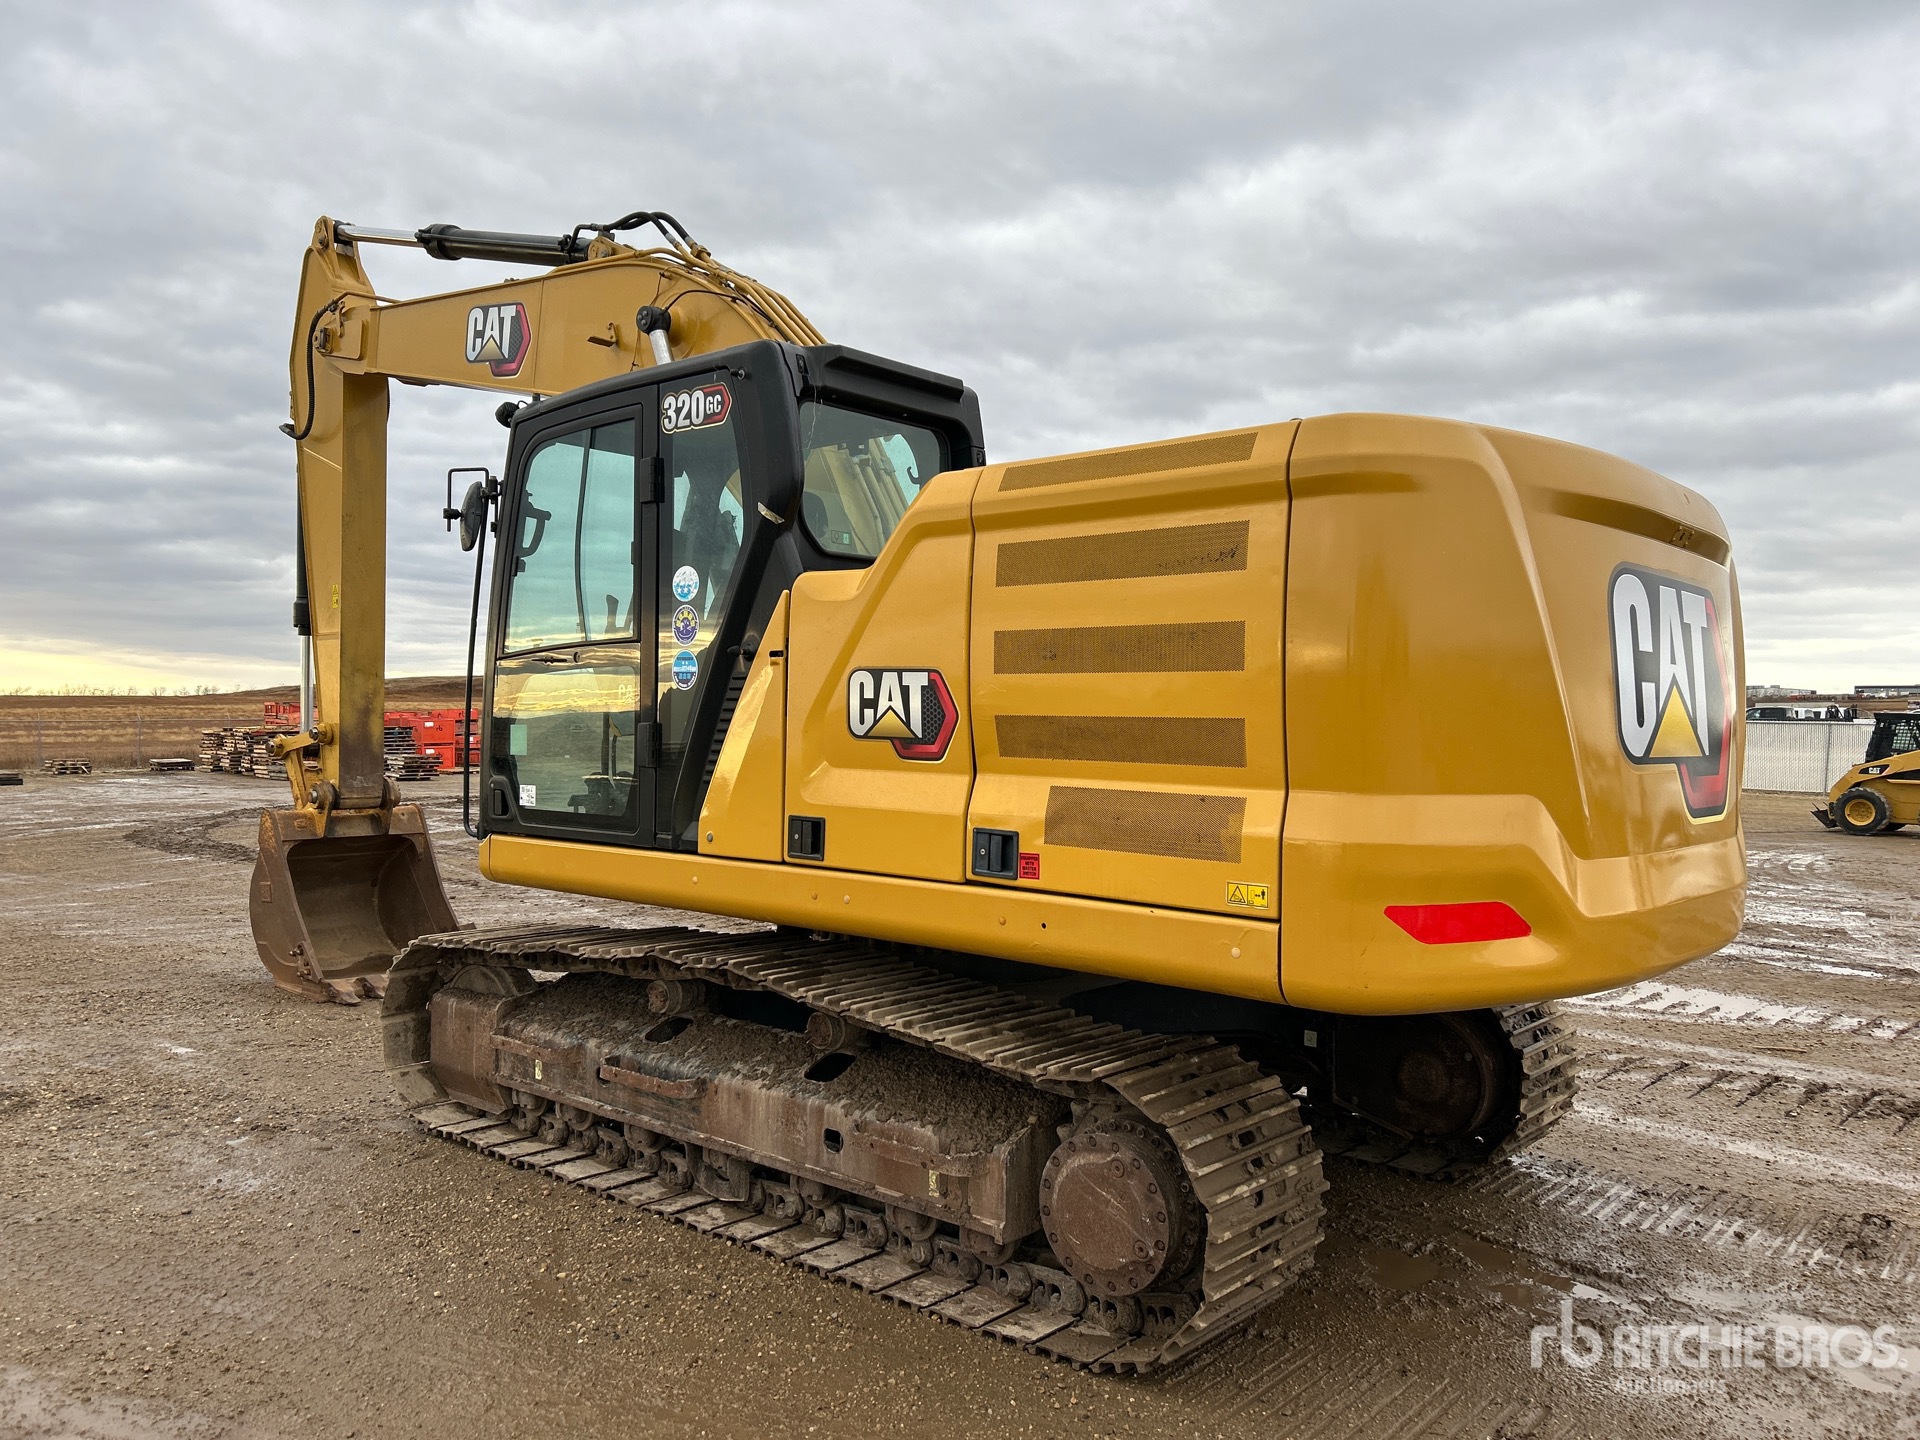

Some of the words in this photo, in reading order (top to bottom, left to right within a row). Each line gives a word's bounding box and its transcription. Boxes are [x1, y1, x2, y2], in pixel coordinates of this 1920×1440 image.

[468, 304, 517, 362] CAT
[663, 390, 705, 431] 320
[1613, 573, 1709, 757] CAT
[849, 670, 929, 738] CAT
